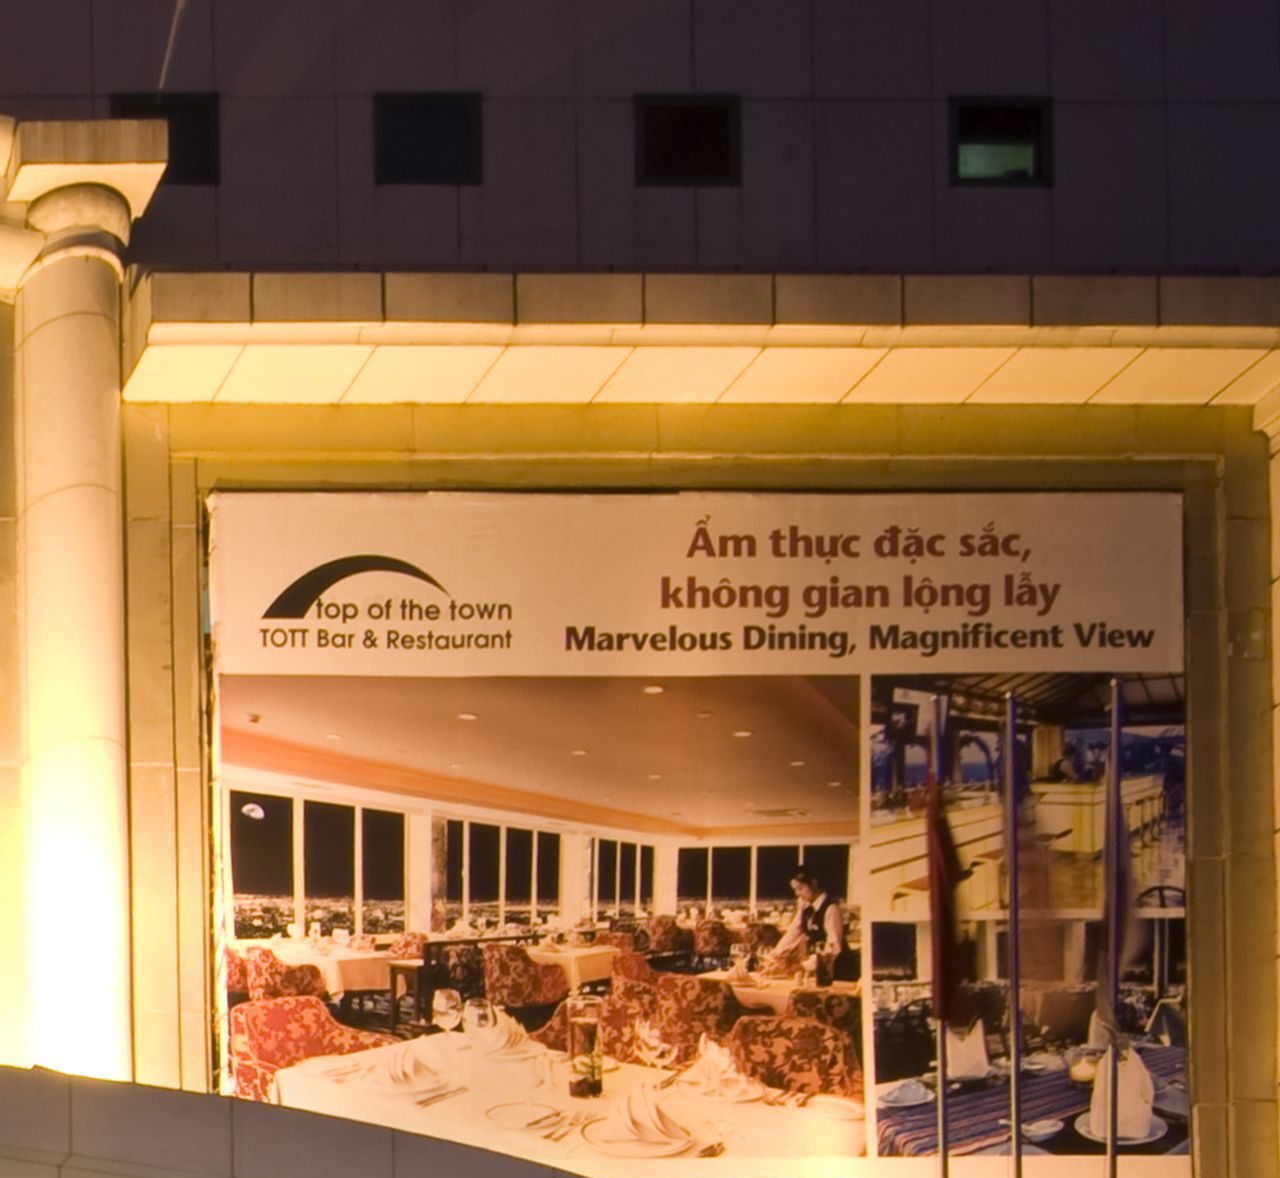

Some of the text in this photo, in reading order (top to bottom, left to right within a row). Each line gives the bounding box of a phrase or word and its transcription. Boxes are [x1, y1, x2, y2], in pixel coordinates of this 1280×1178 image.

[687, 514, 1032, 564] Ẩm thực đặc sắc,
[315, 597, 513, 624] top of the town
[660, 571, 1061, 618] không gian lộng lẫy
[260, 628, 513, 650] TOTT Bar & Restaurant
[565, 622, 1156, 656] Marvelous Dining, Magnificent View
